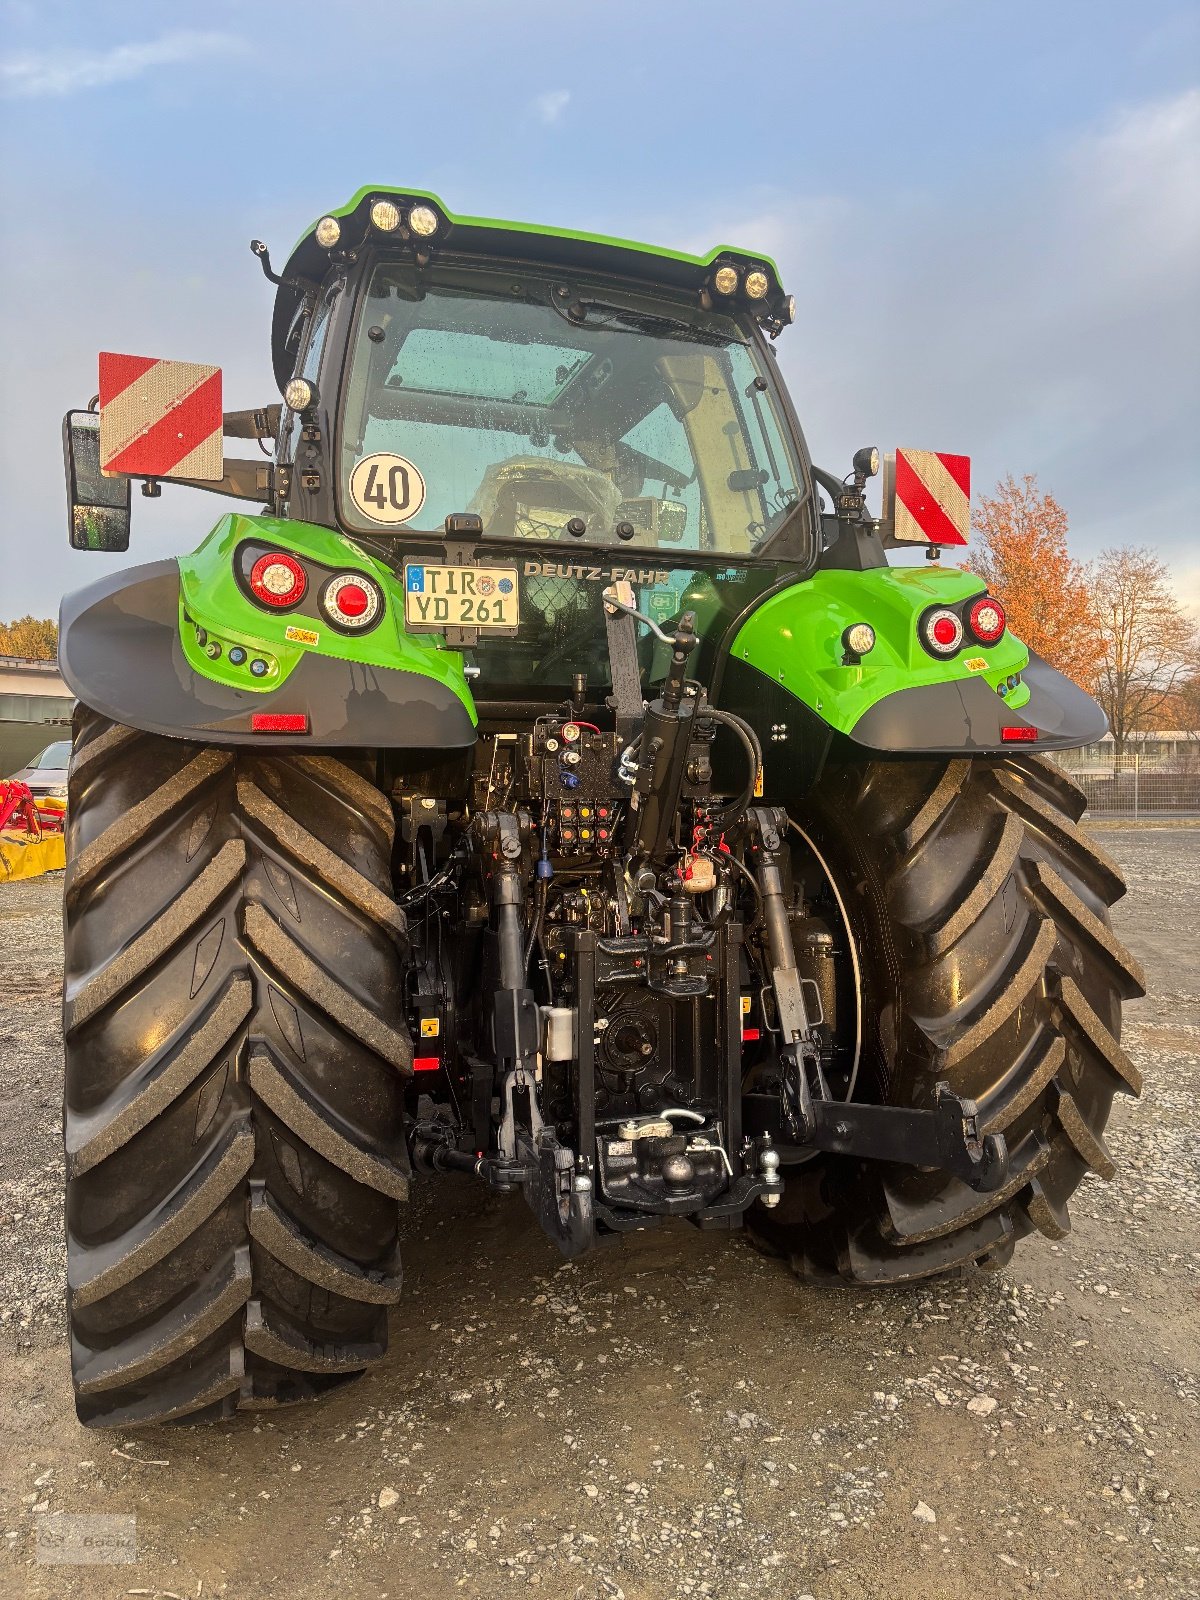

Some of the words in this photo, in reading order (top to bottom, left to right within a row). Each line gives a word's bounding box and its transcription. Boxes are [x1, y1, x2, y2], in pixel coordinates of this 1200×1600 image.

[363, 464, 410, 510] 40
[412, 582, 420, 591] D
[426, 569, 477, 596] TIR
[524, 561, 670, 585] DEUTZ-FAHR
[415, 596, 450, 621] YD
[460, 598, 507, 623] 261
